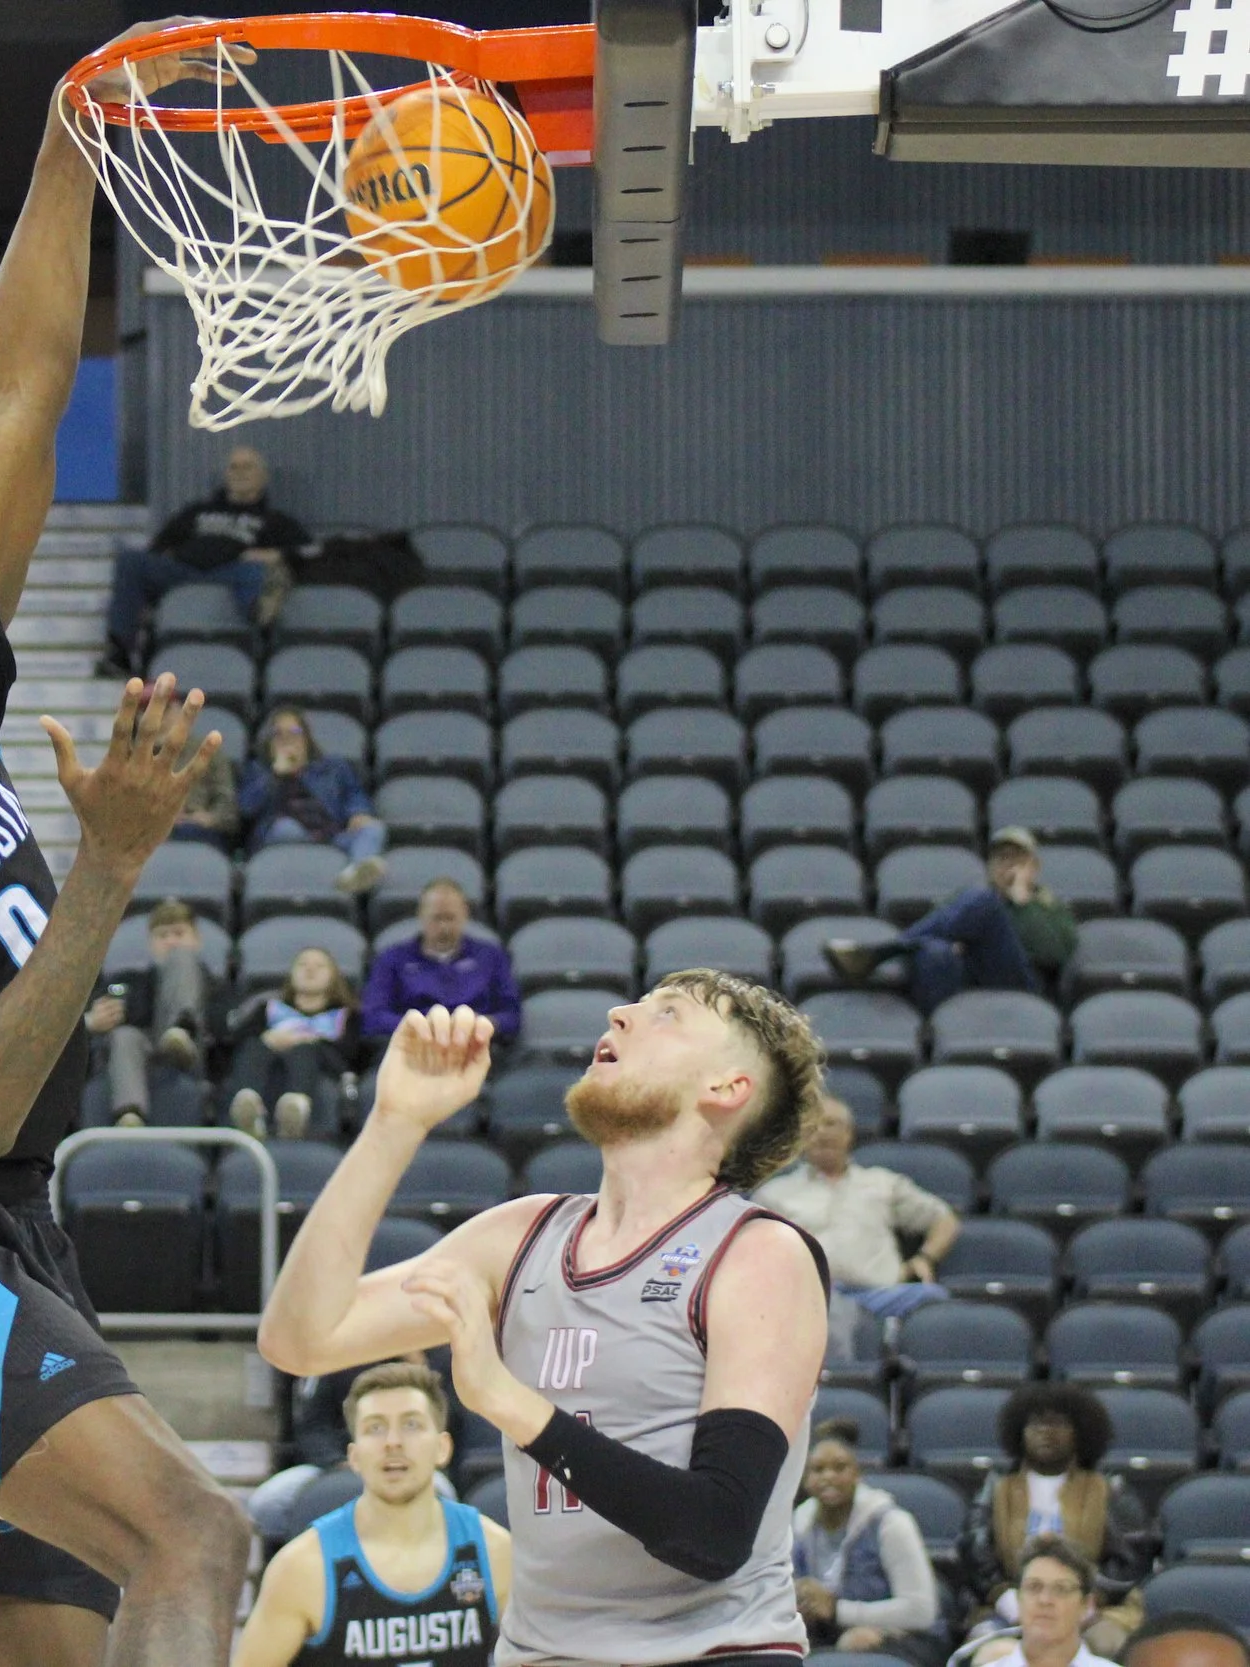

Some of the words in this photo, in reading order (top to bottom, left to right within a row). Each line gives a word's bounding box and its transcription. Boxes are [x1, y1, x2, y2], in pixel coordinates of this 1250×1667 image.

[641, 1285, 682, 1297] PSAC
[537, 1327, 599, 1389] IUP
[344, 1607, 483, 1659] AUGUSTA
